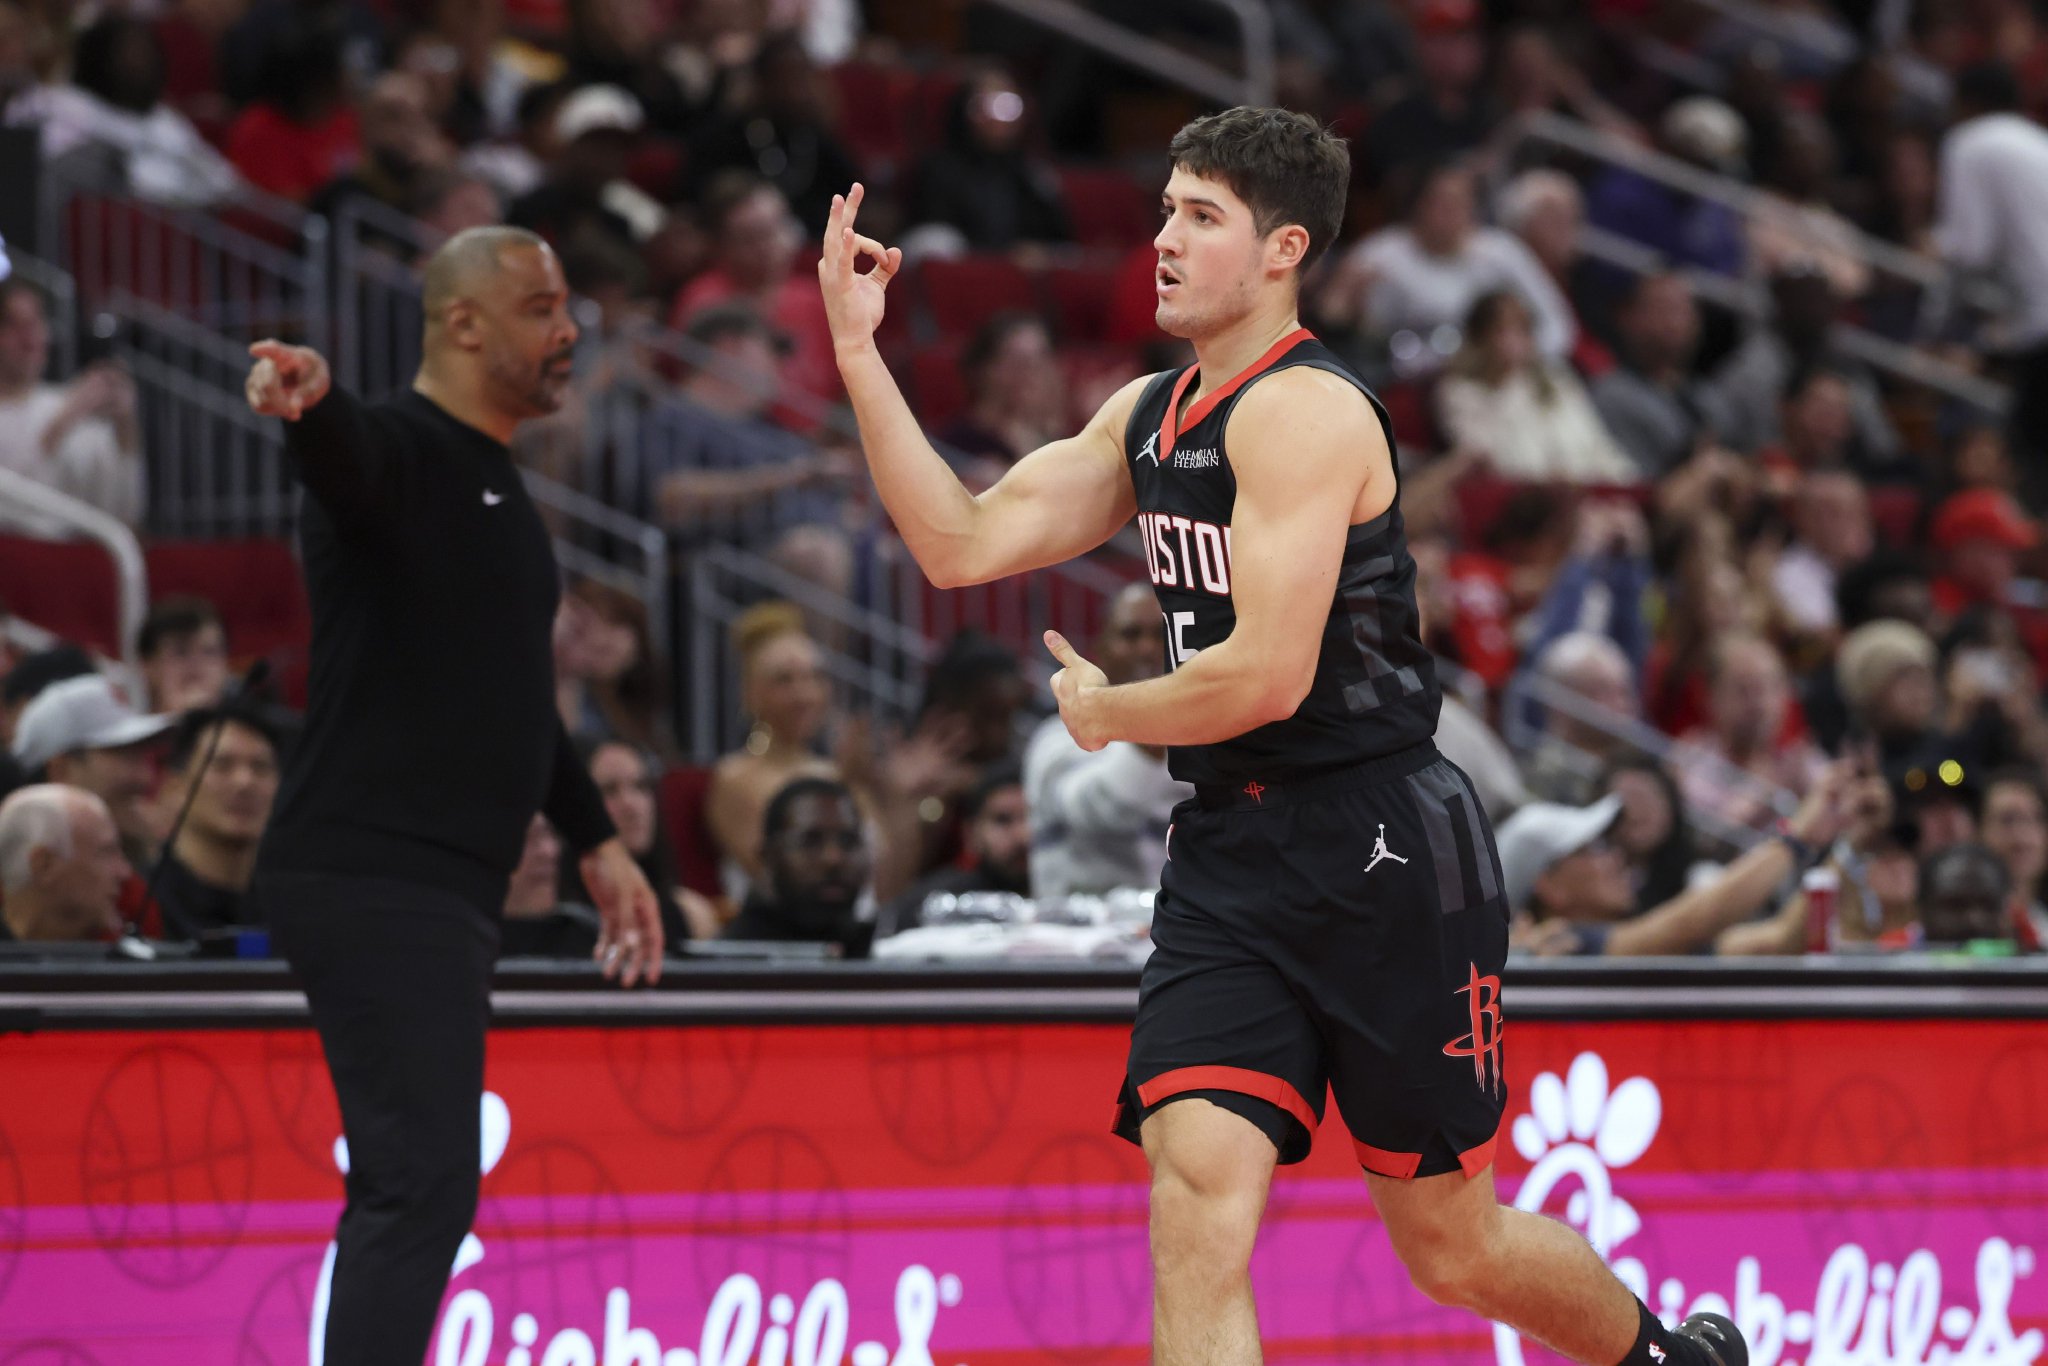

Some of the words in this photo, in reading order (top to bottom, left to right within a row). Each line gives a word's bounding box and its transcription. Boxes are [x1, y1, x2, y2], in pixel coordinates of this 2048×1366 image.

[1174, 448, 1220, 460] MEMIAL
[1173, 457, 1219, 469] HERNN
[1137, 512, 1231, 595] USTO
